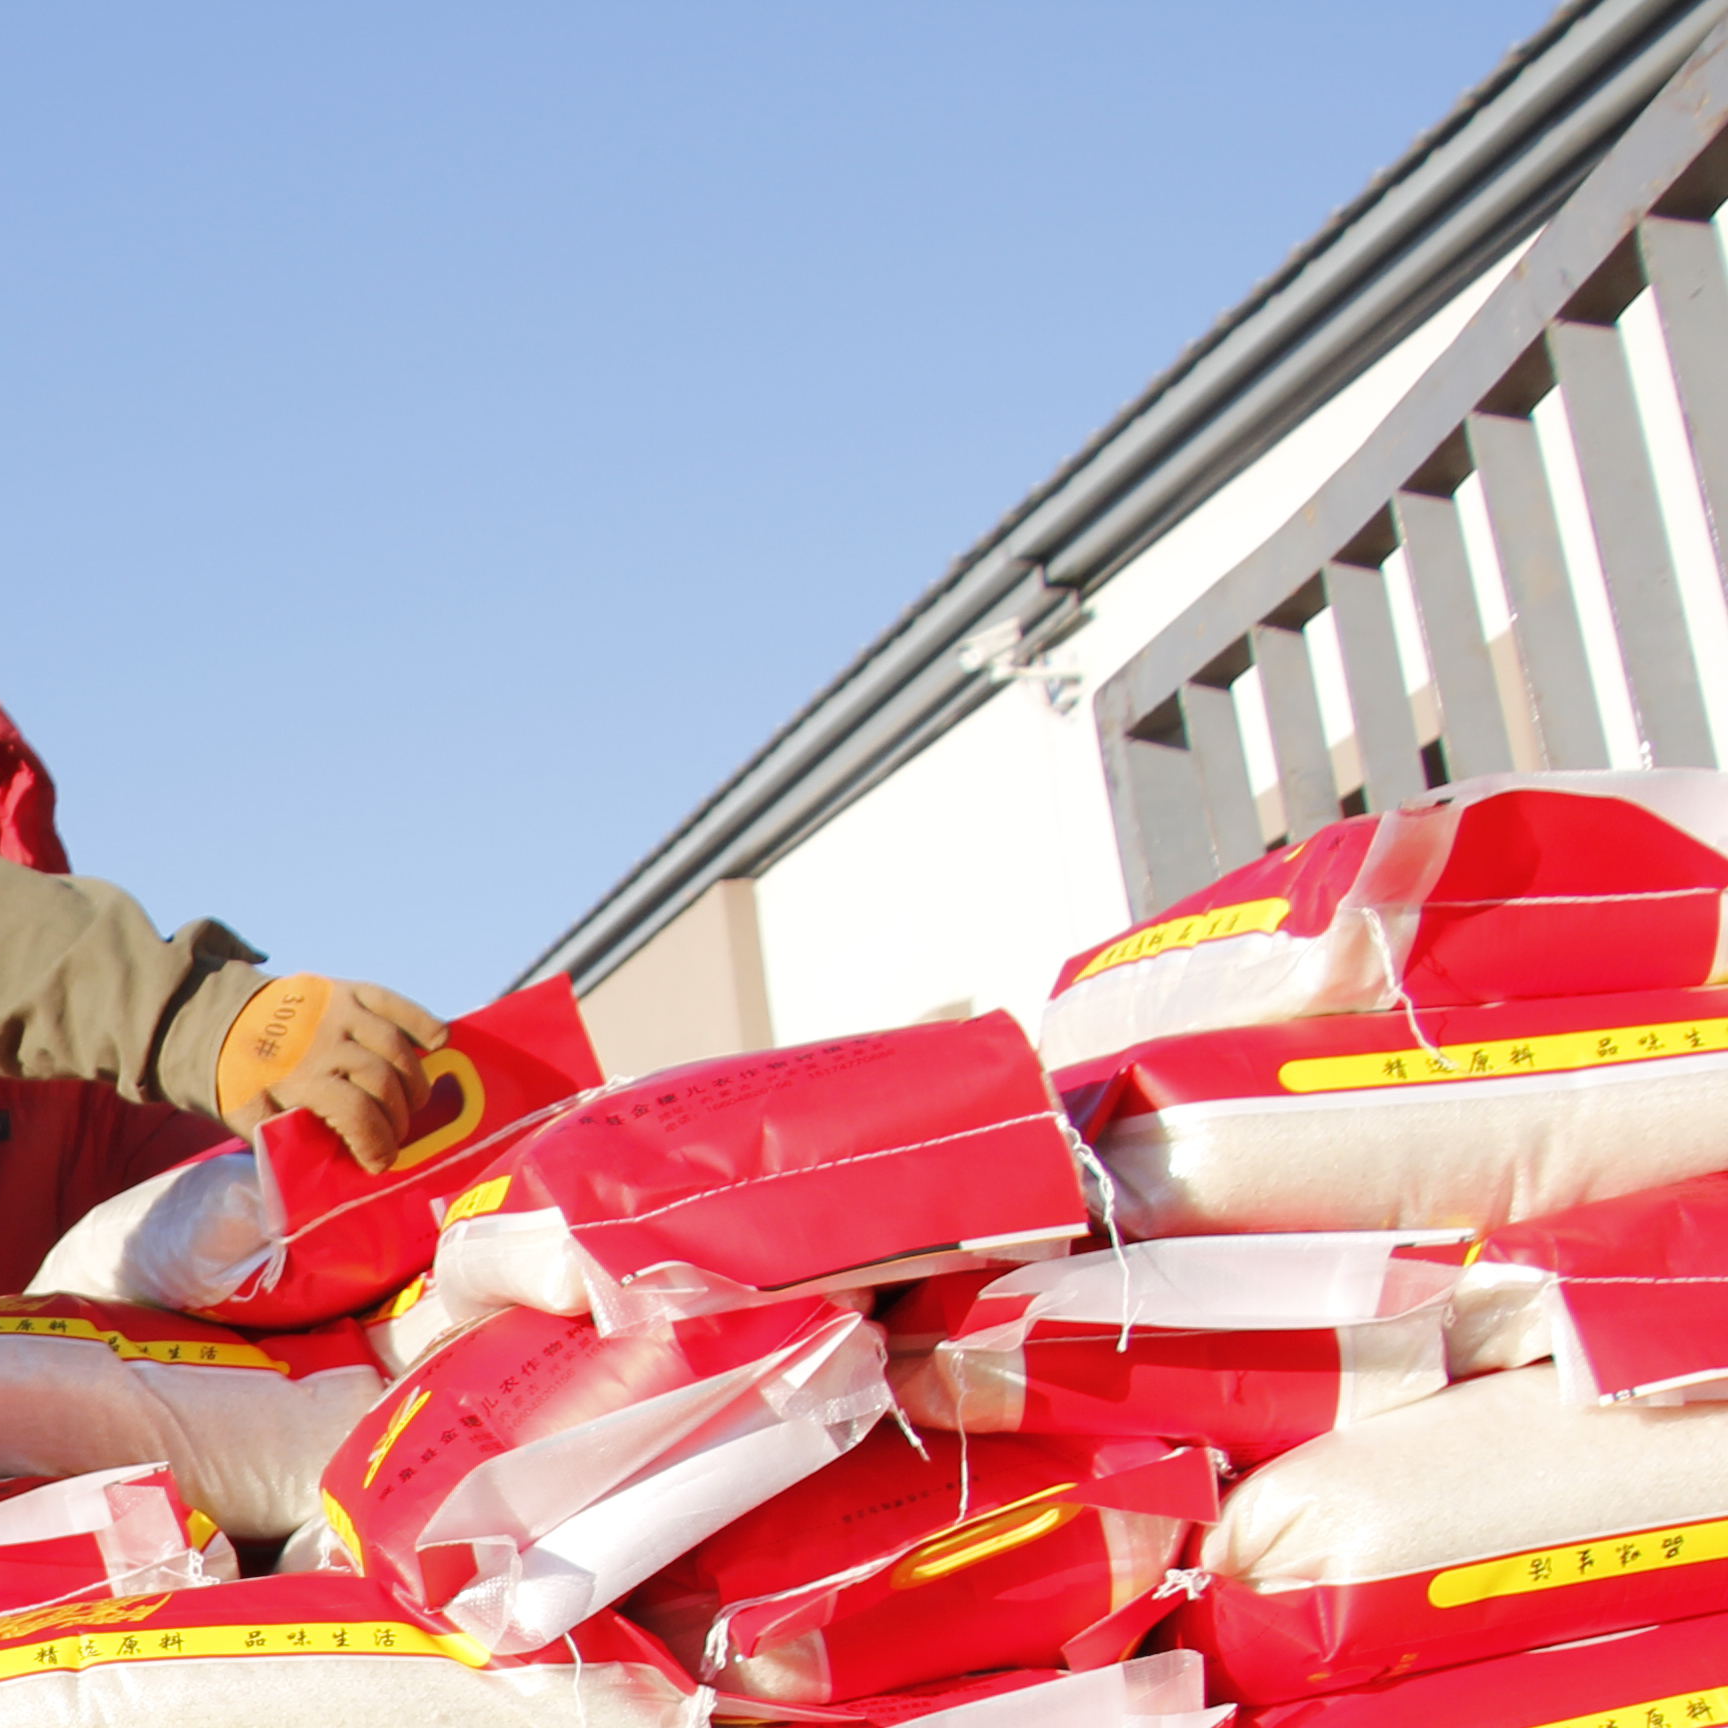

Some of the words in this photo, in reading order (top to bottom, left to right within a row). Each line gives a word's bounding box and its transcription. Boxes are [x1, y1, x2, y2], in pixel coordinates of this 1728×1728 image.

[1596, 1027, 1728, 1057] 品味生
[1527, 1533, 1685, 1581] 品味生活
[34, 1631, 185, 1665] 精选原料
[244, 1627, 397, 1648] 品味生活
